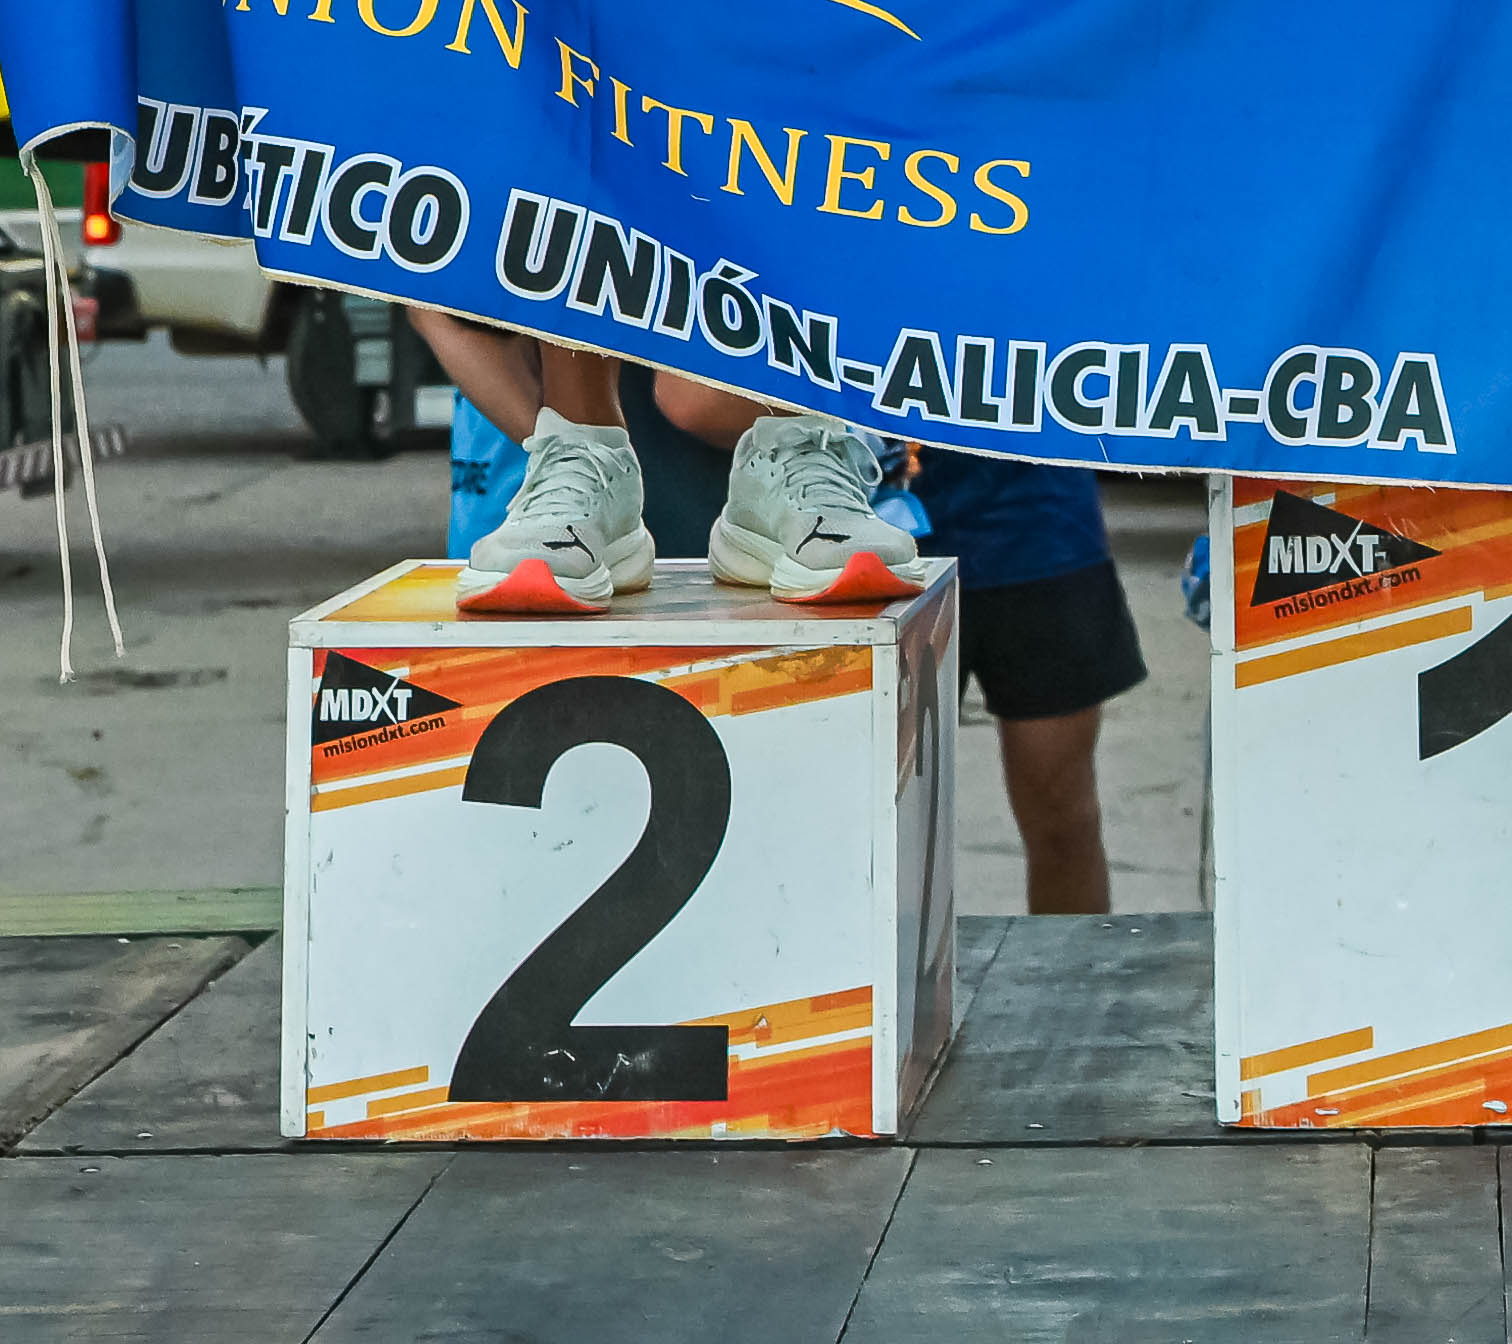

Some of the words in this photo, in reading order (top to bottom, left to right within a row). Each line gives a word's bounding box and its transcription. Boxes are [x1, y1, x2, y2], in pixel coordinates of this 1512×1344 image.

[554, 36, 1032, 236] FITNESS
[1268, 519, 1380, 578] MDXT
[320, 677, 413, 724] MDXT
[323, 716, 446, 759] misiondxt.com
[448, 675, 732, 1102] 2
